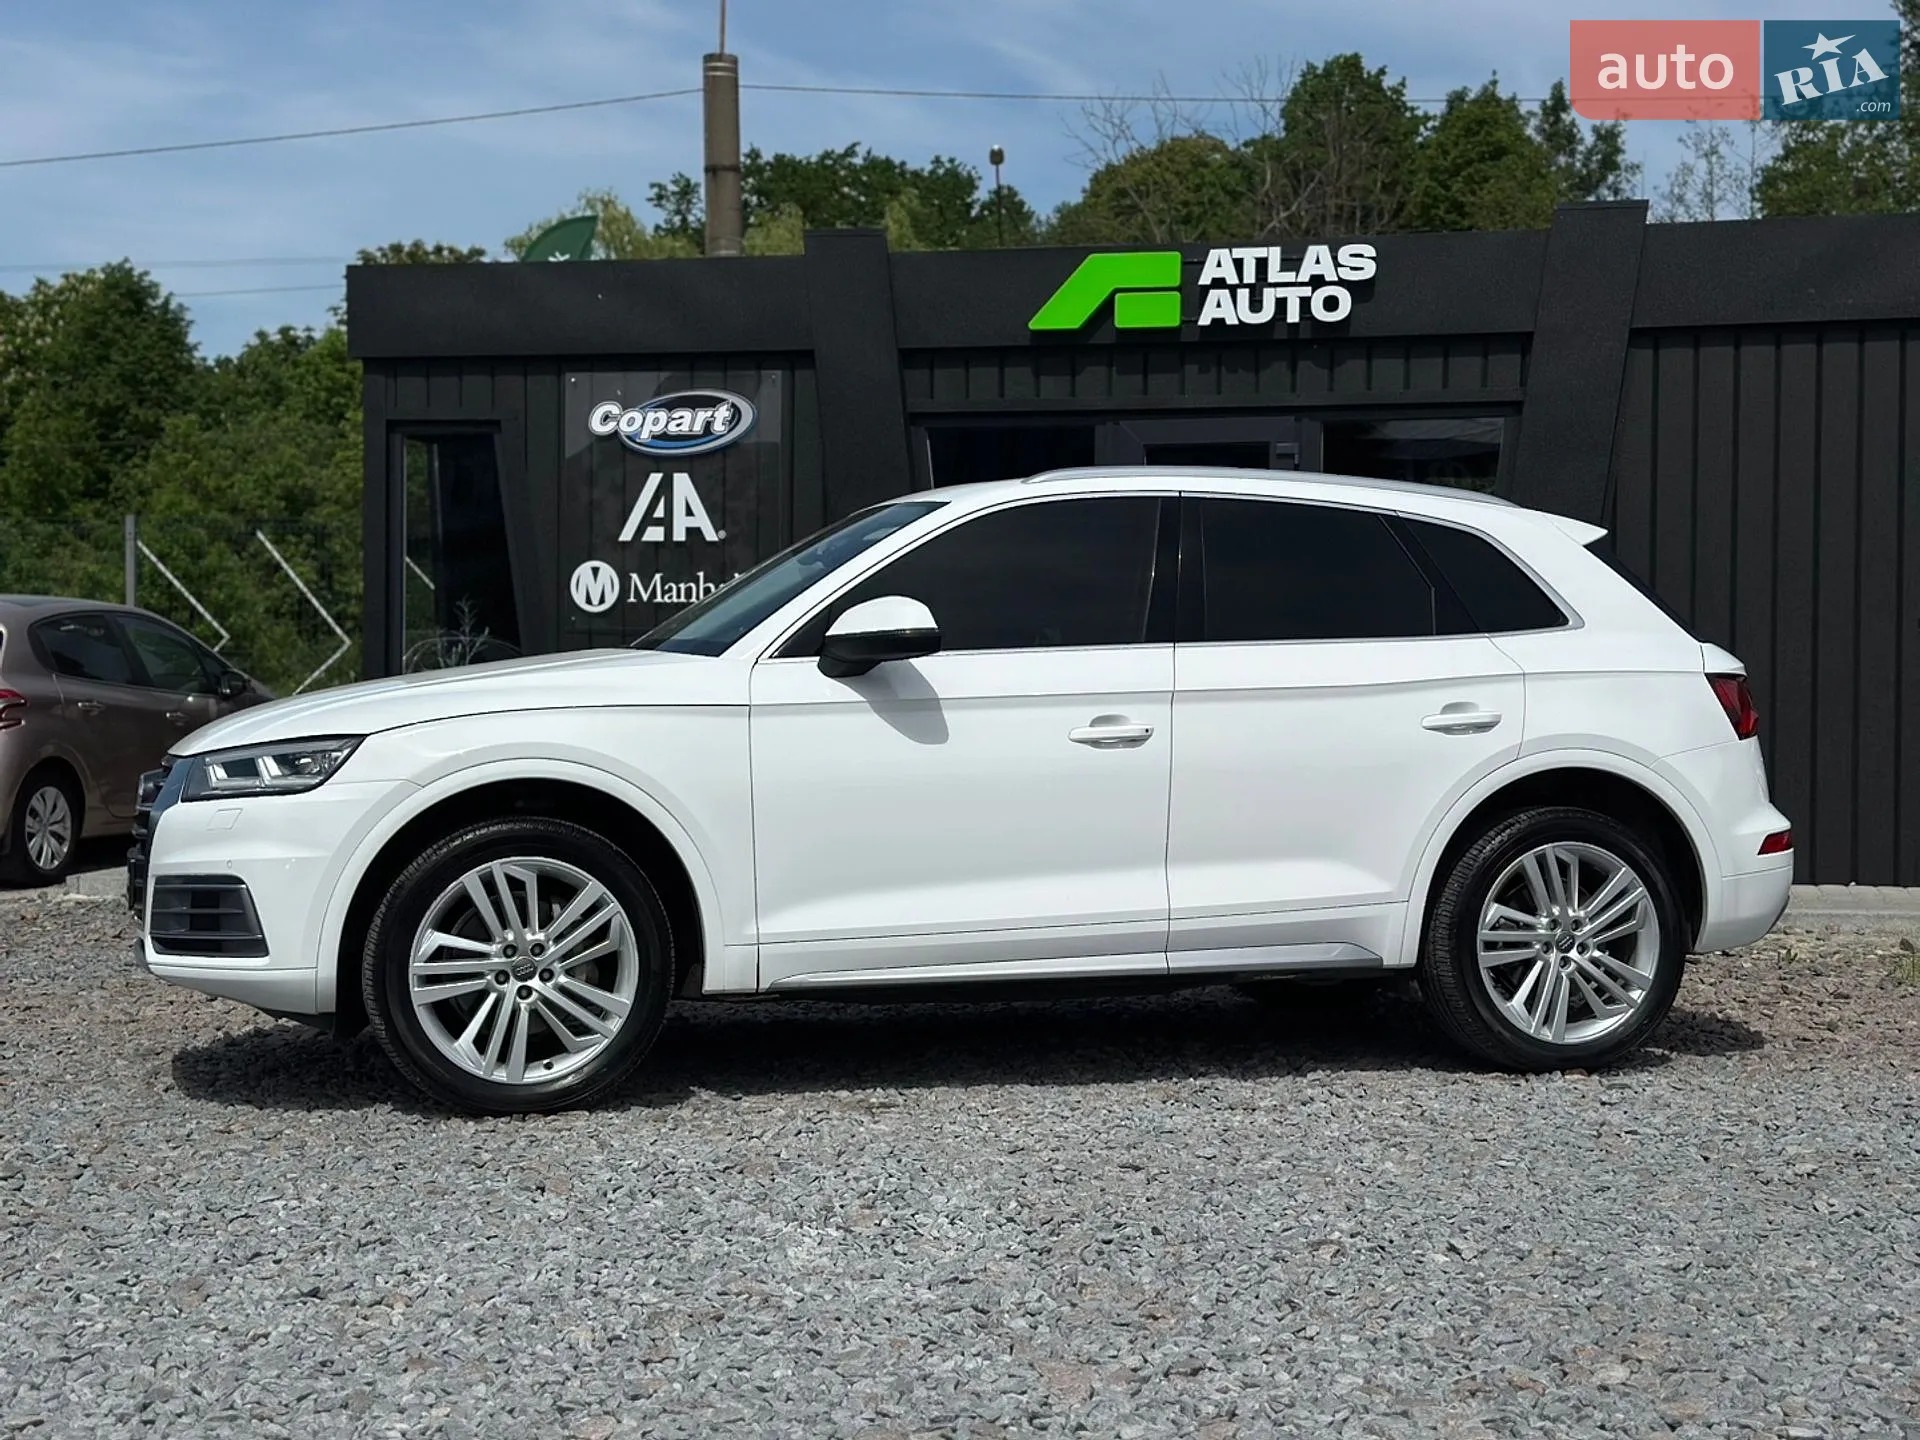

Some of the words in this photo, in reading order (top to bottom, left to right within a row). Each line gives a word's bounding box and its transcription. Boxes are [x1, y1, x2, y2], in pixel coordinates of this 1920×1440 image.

[1198, 243, 1376, 285] ATLAS
[1197, 285, 1352, 326] AUTO
[588, 400, 735, 442] Copart
